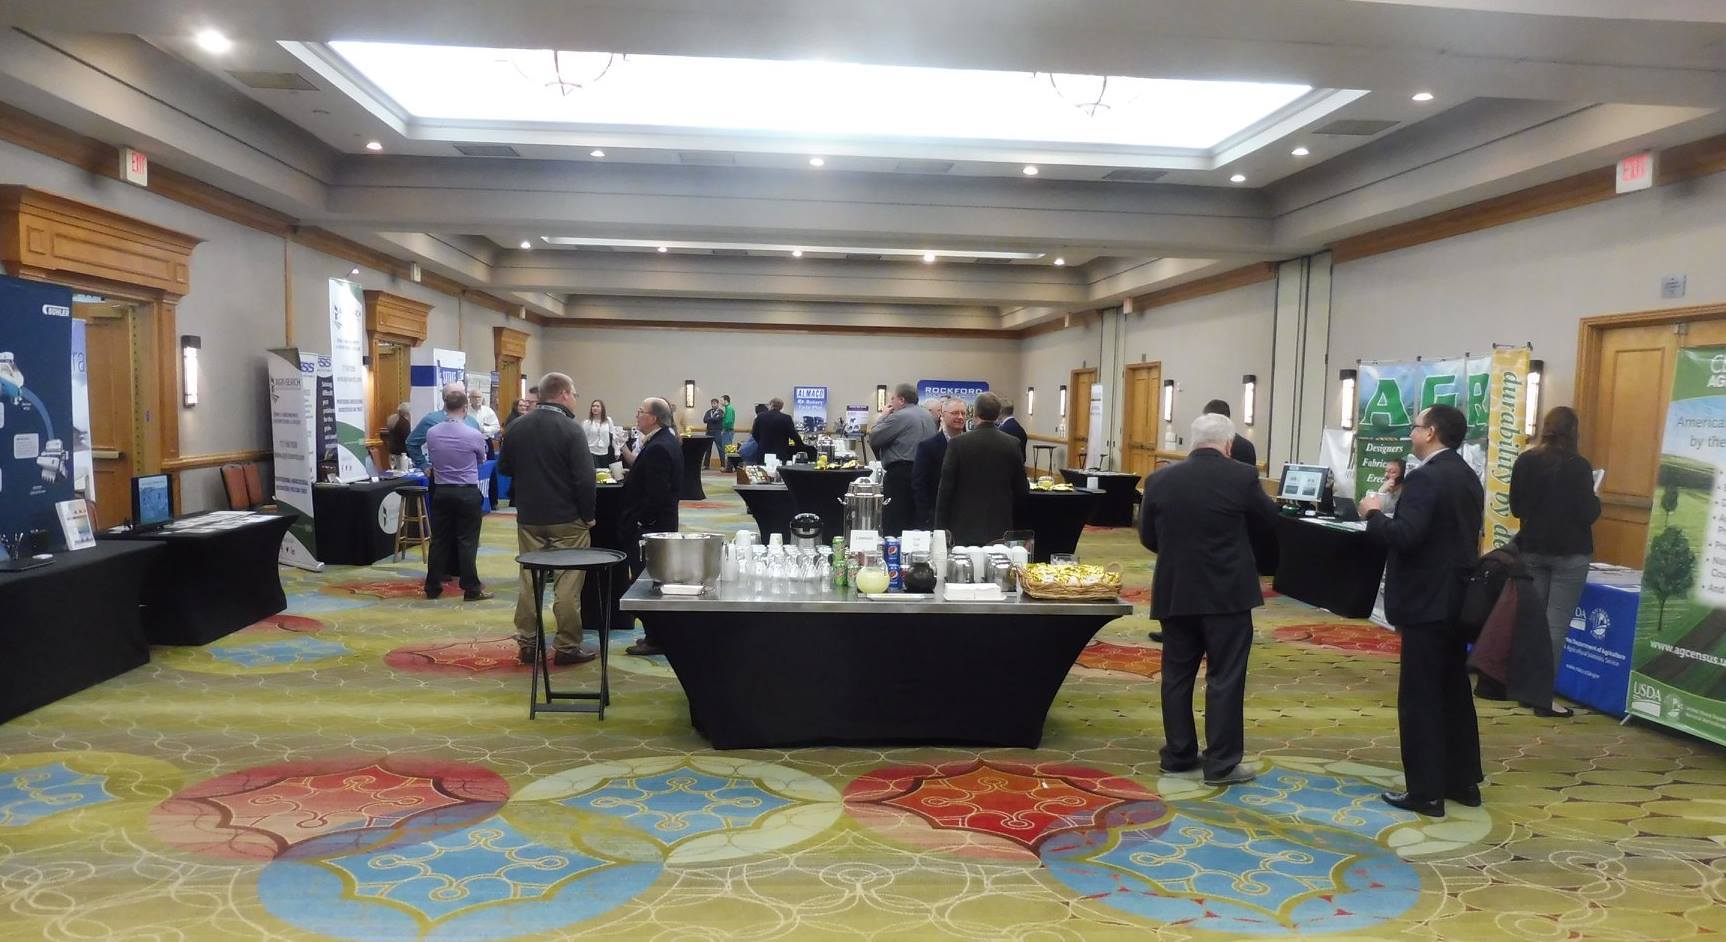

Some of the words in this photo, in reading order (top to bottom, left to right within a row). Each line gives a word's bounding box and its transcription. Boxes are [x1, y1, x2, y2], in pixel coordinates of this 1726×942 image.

[797, 388, 825, 398] ALMACO
[925, 386, 983, 395] ROCKFORD
[1492, 371, 1521, 484] durability
[1366, 442, 1404, 454] Designers
[1690, 435, 1702, 449] by
[1708, 436, 1726, 448] the
[1362, 457, 1388, 468] Fabric
[1366, 473, 1385, 483] Erec
[1493, 524, 1512, 549] de
[1633, 681, 1662, 701] USDA
